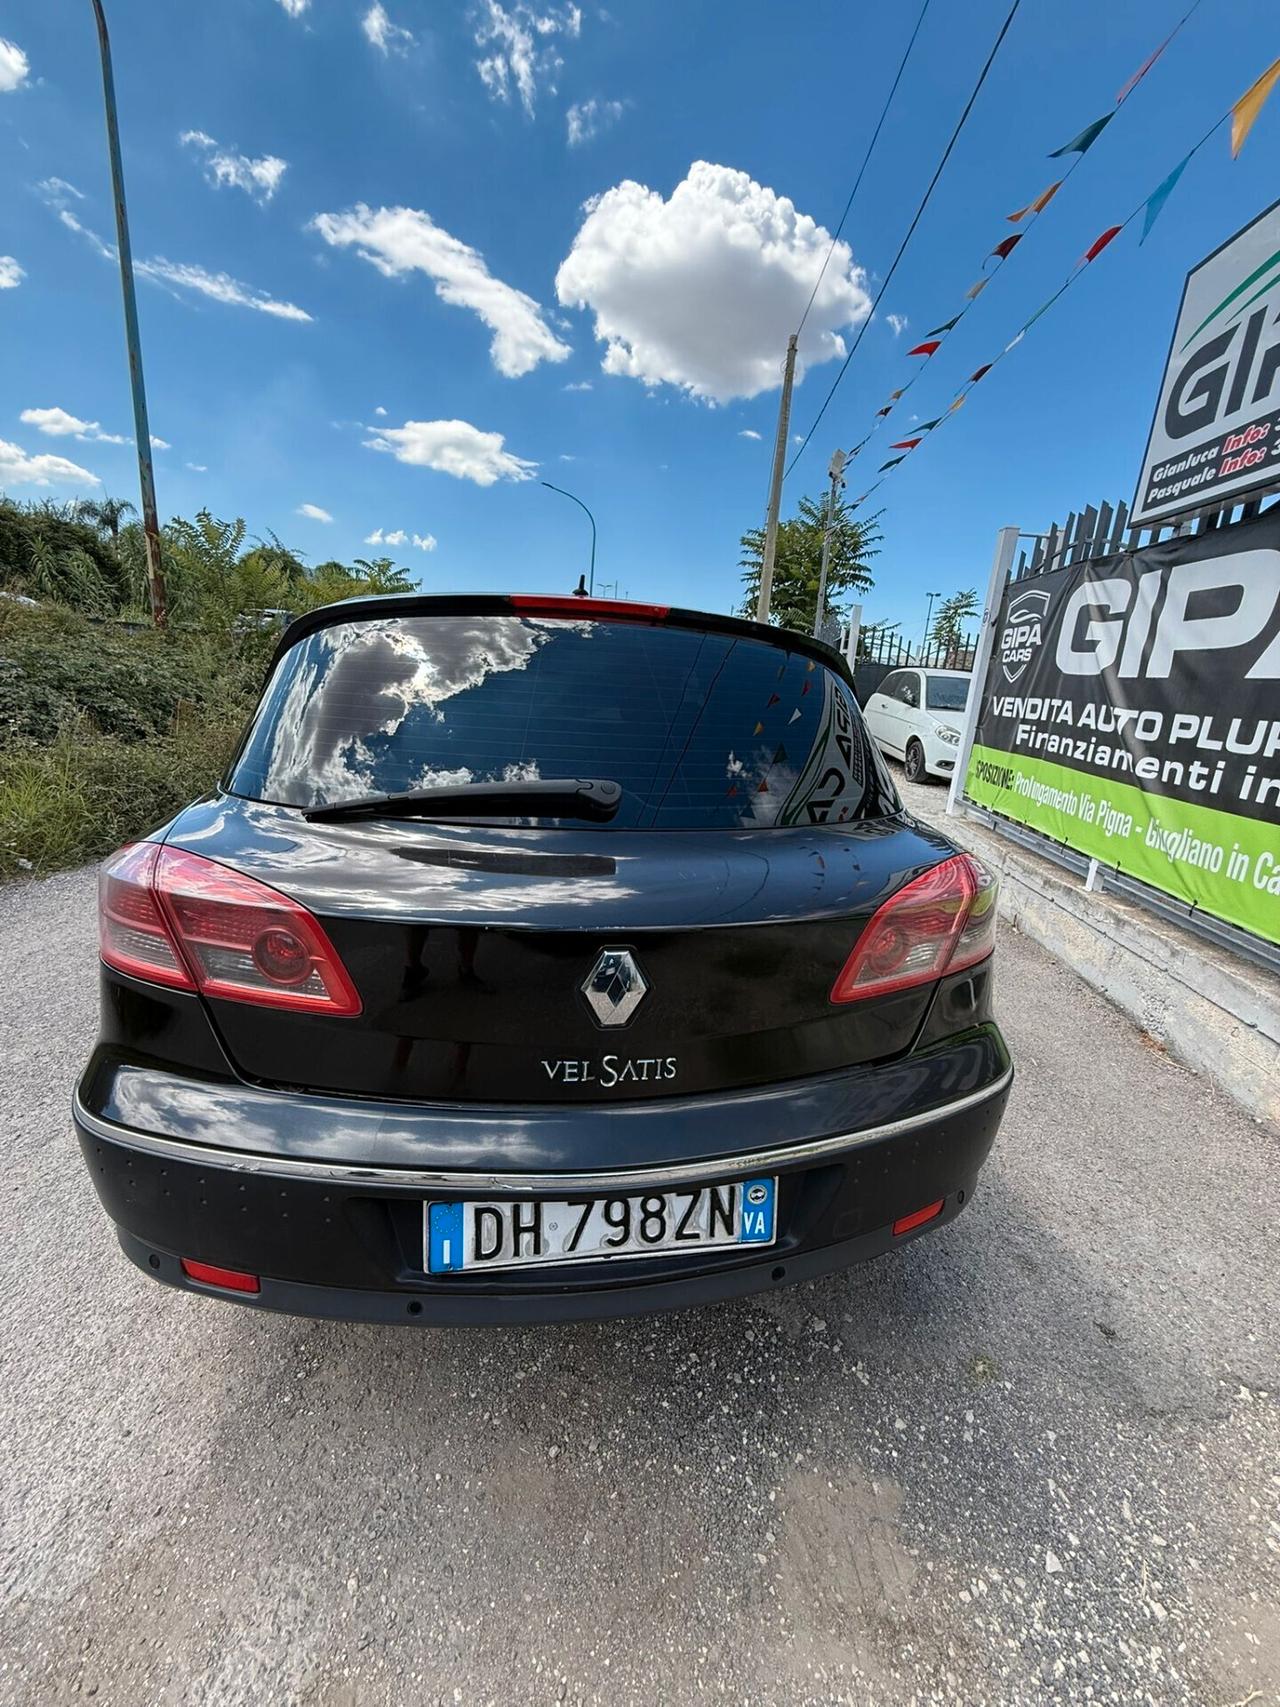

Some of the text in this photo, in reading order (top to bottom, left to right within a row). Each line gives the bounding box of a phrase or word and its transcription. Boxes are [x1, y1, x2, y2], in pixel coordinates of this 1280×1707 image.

[1147, 447, 1267, 503] Pasquale Info:
[1153, 446, 1219, 482] Gianluca
[1222, 423, 1271, 455] Info:
[1001, 623, 1042, 650] GIPA
[1056, 549, 1280, 679] GIP
[1002, 648, 1032, 663] CARS
[993, 696, 1073, 726] VENDITA
[1077, 703, 1163, 741] AUTO
[1078, 792, 1096, 823] Via
[1096, 800, 1132, 837] Pigna
[1226, 843, 1250, 882] in
[541, 1061, 596, 1082] VEL
[474, 1203, 542, 1261] DH
[566, 1187, 735, 1252] 798ZN
[743, 1212, 765, 1235] VA
